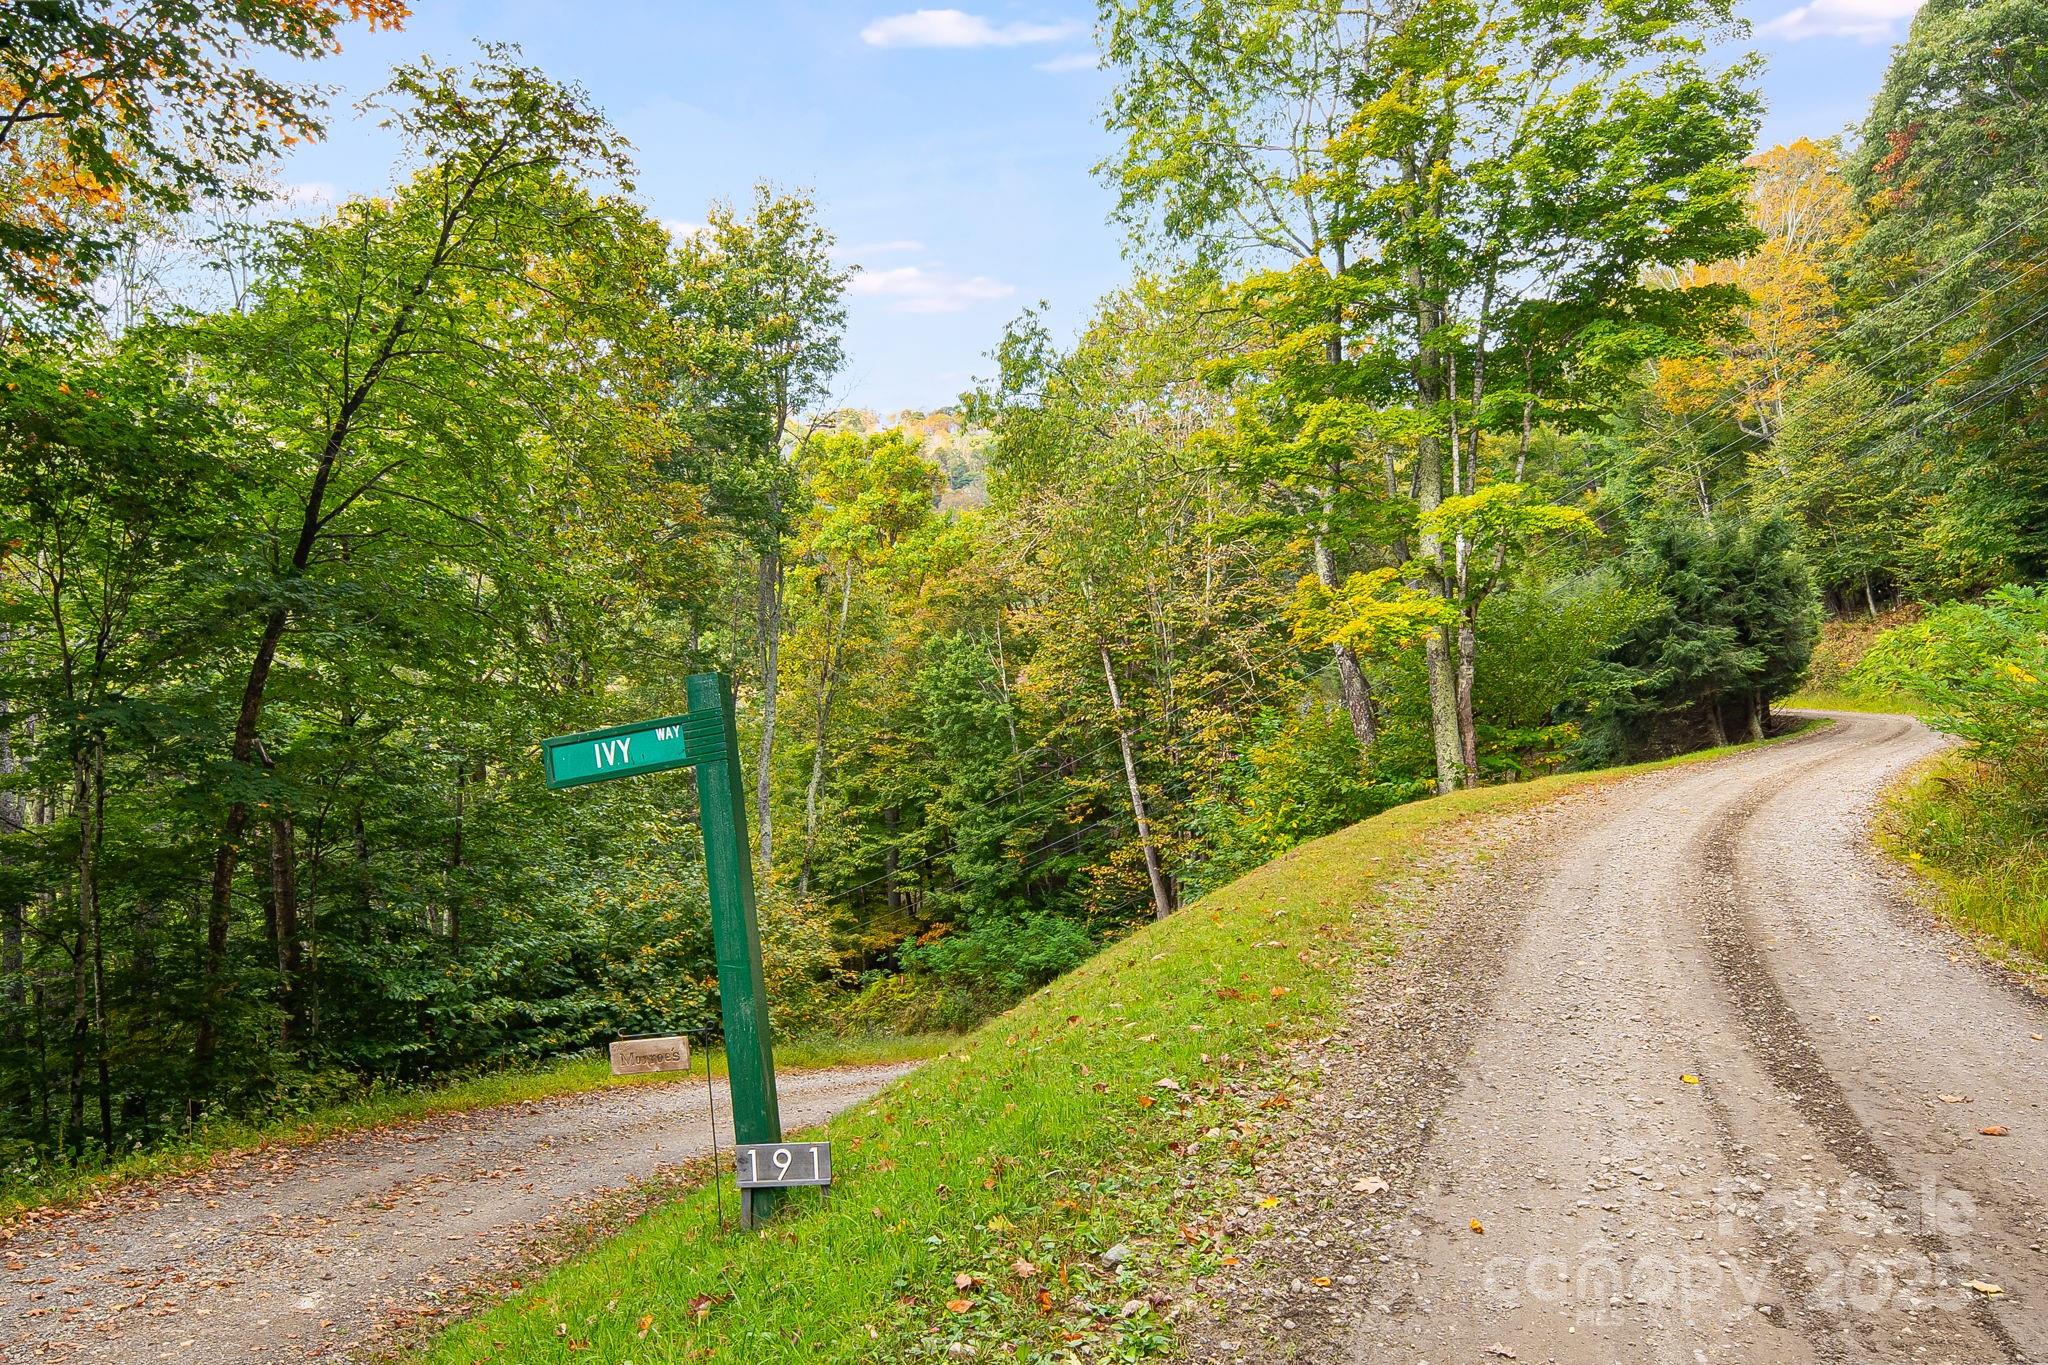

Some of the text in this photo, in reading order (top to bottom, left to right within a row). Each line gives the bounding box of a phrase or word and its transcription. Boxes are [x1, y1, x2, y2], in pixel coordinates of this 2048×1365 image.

[594, 725, 680, 769] IVY WAY
[747, 1147, 819, 1182] 191
